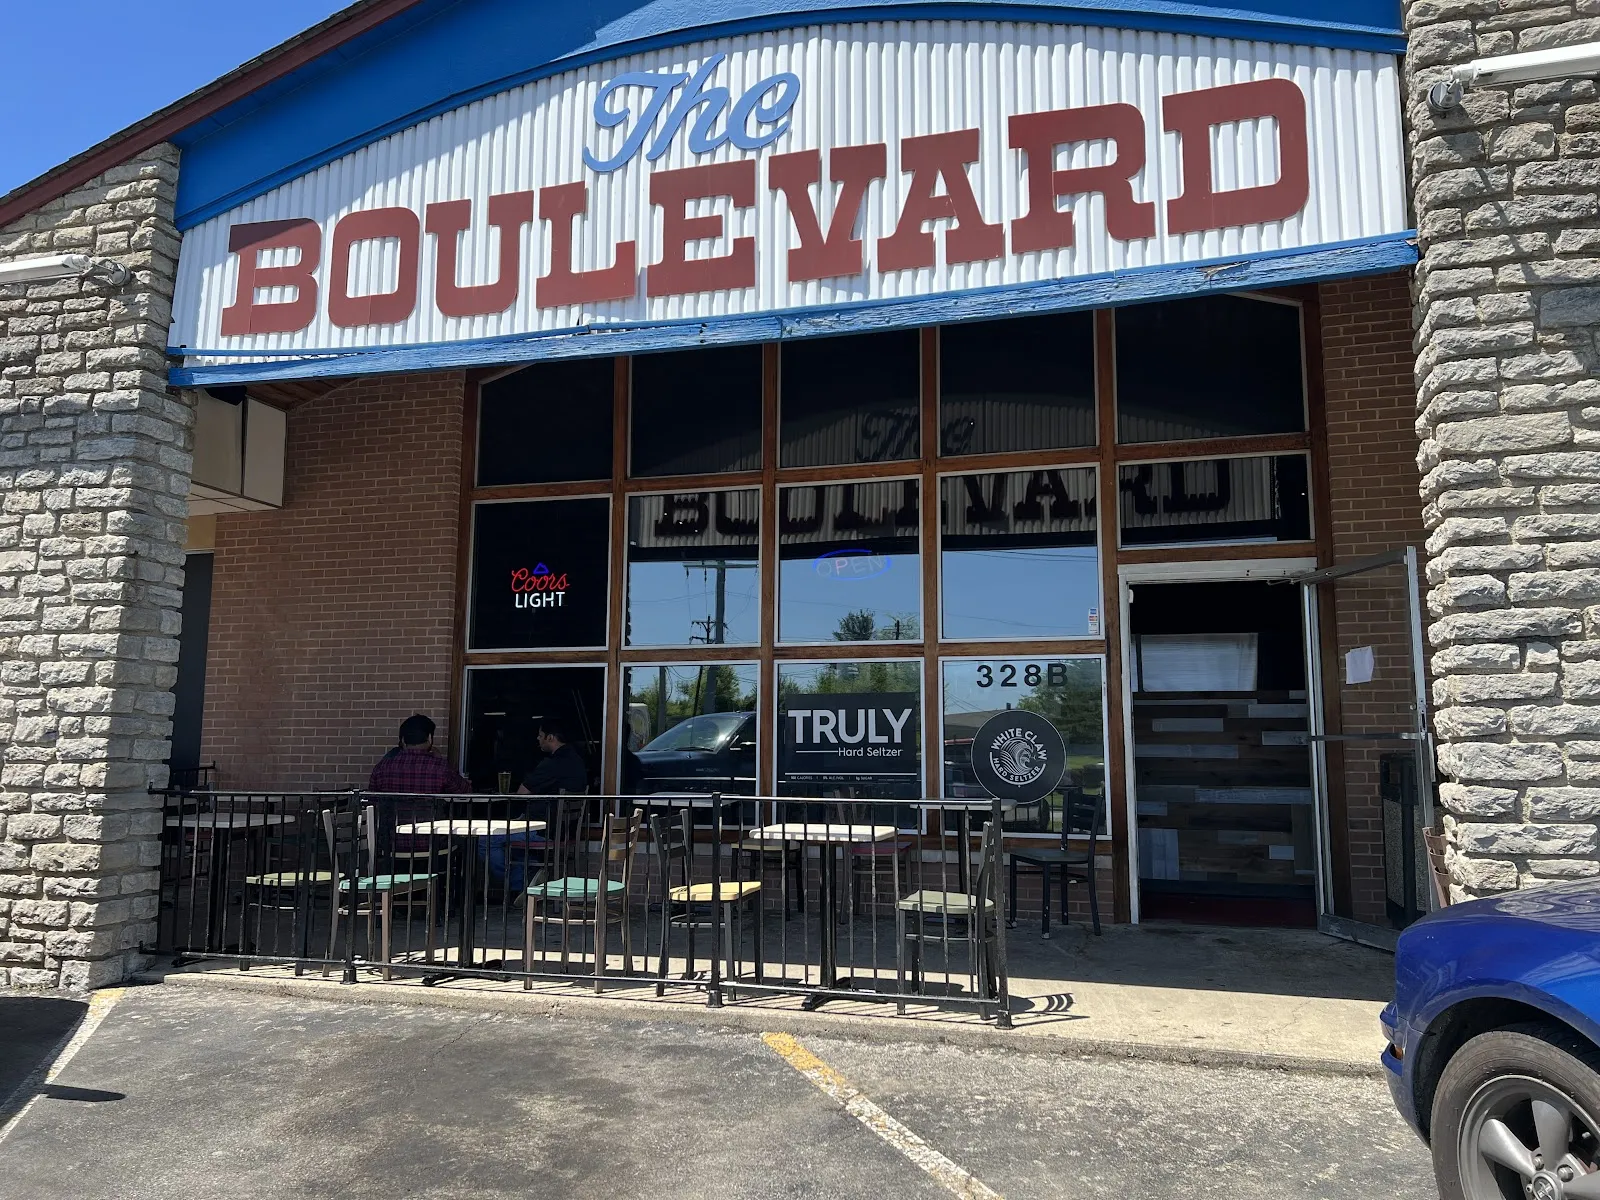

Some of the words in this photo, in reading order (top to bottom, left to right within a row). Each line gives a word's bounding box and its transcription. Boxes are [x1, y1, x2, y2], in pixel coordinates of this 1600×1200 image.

[583, 52, 800, 172] The
[221, 78, 1309, 337] BOULEVARD
[816, 553, 884, 577] OPEN
[511, 567, 570, 592] Coors
[515, 591, 566, 609] LIGHT
[976, 663, 1068, 688] 328B
[787, 708, 913, 744] TRULY
[838, 747, 864, 757] Hard
[866, 746, 902, 757] Seltzer
[990, 728, 1022, 750] WHITE
[1024, 730, 1048, 760] CLAW
[993, 757, 1008, 777] HARD
[1009, 766, 1041, 782] SELTZER
